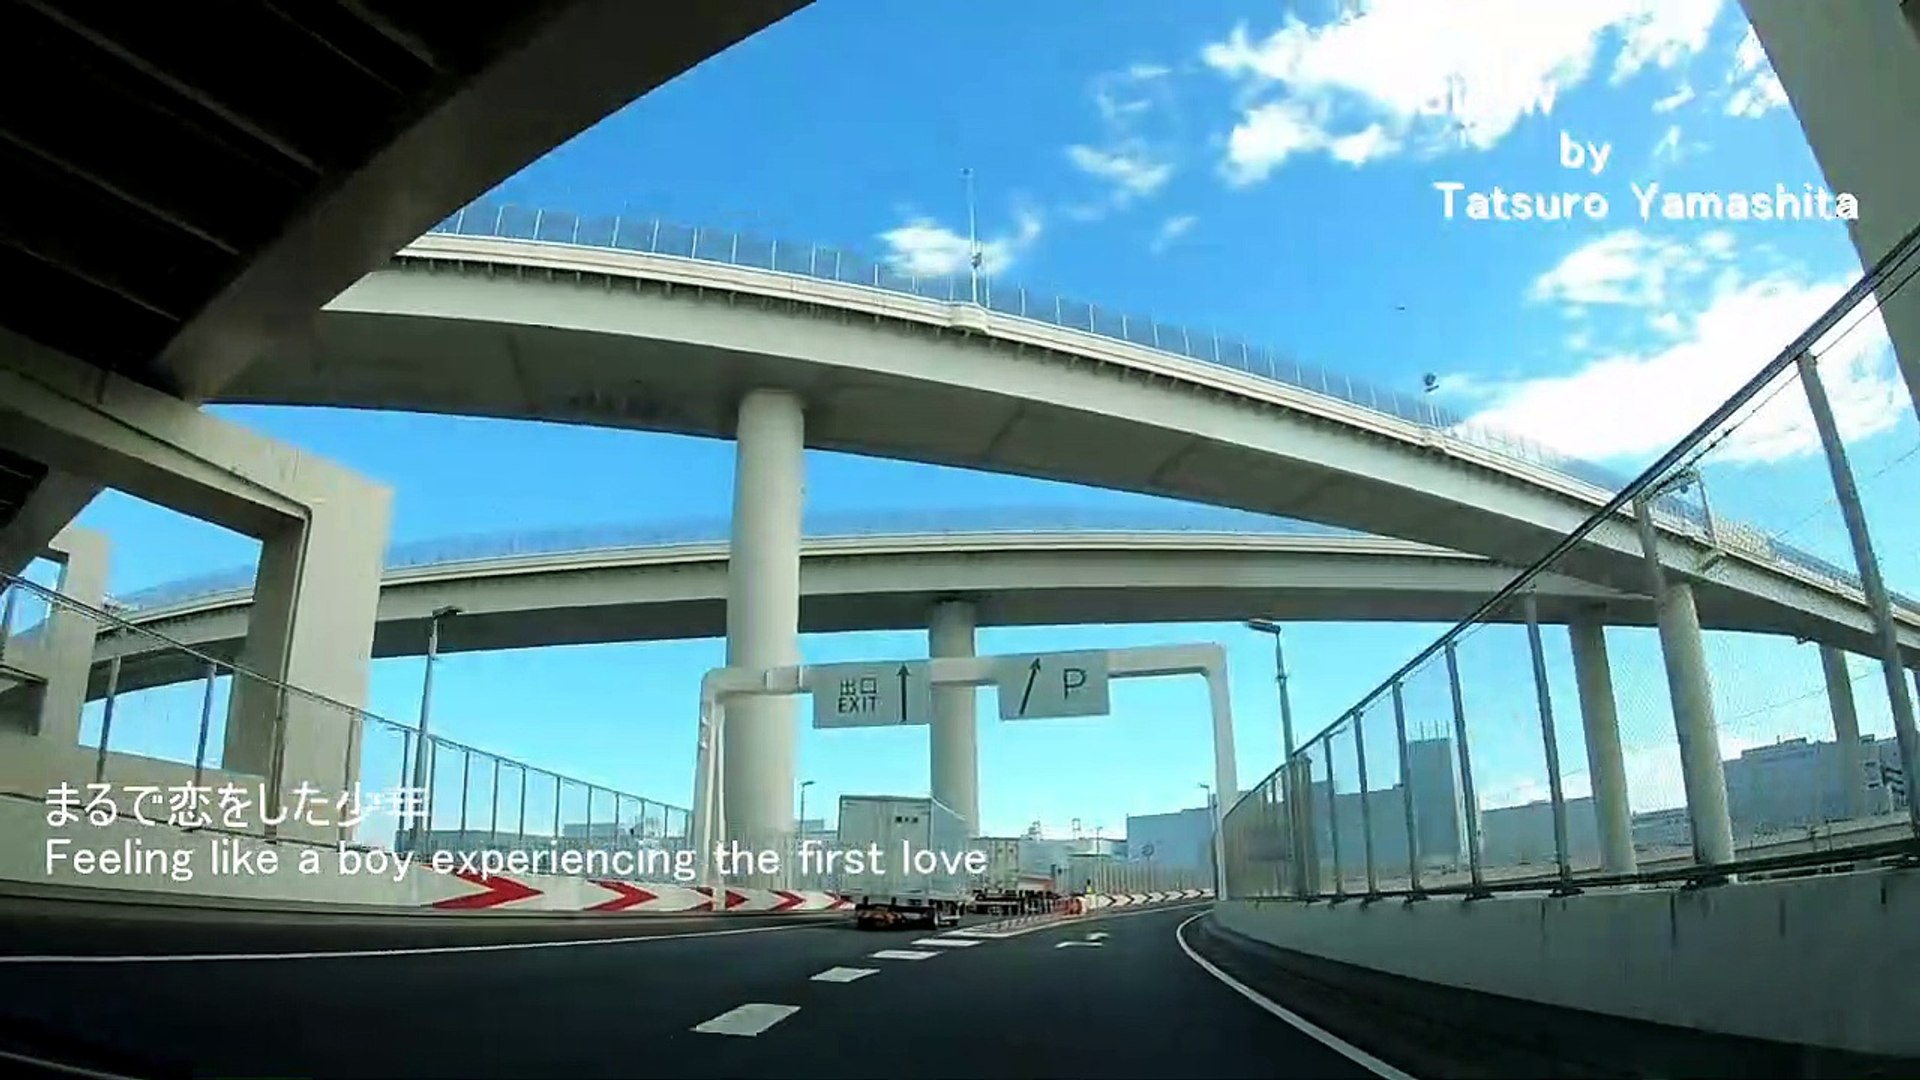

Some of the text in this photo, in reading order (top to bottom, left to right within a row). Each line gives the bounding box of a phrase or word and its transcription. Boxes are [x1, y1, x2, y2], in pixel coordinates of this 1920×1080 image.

[839, 677, 878, 696] 出口
[1063, 668, 1087, 700] P
[838, 695, 878, 714] EXIT
